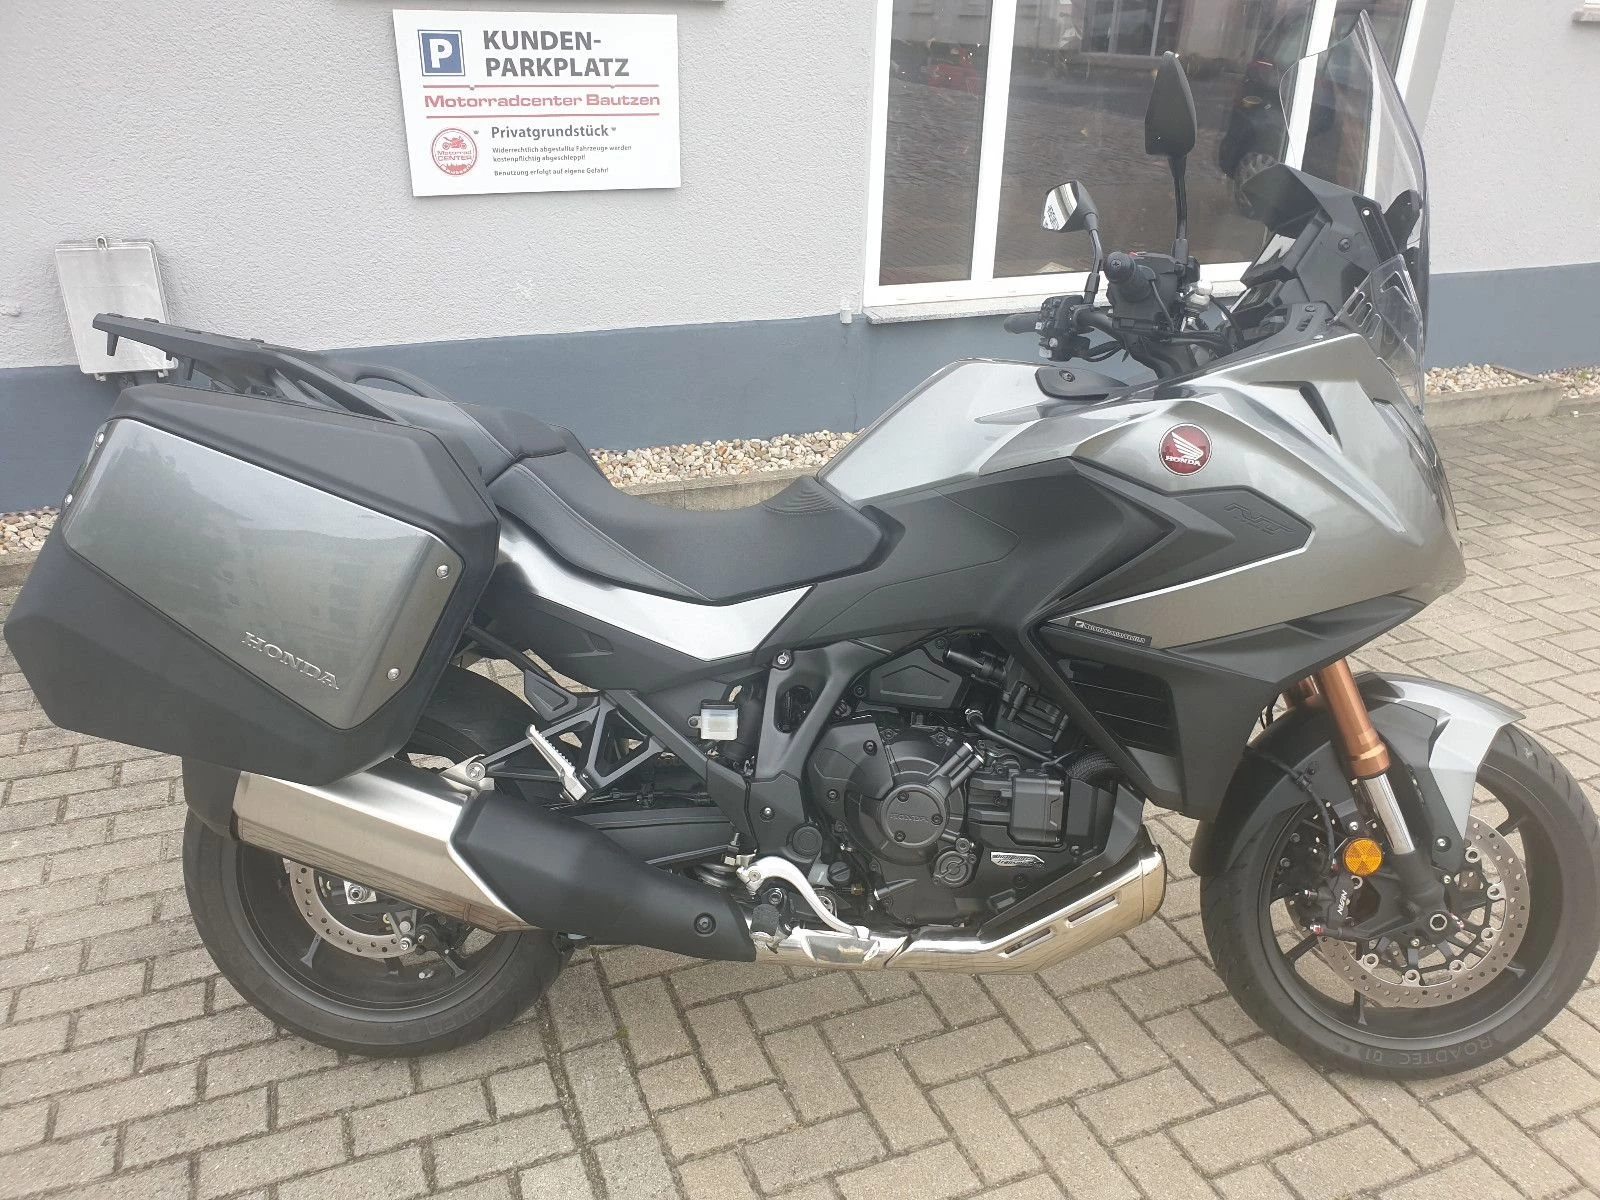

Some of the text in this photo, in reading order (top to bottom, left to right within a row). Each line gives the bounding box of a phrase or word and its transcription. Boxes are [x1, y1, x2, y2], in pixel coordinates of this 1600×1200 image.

[483, 29, 602, 51] KUNDEN-
[429, 38, 453, 69] P
[485, 57, 630, 77] PARKPLATZ
[424, 93, 661, 108] Motorradcenter Bautzen
[491, 124, 610, 141] Privatgrundstück
[540, 145, 574, 153] abgestellte
[576, 145, 608, 153] Fahrzeuge
[494, 169, 529, 177] Benutzung
[1165, 455, 1202, 467] HONDA
[241, 631, 340, 690] HONDA
[1399, 1035, 1494, 1066] ROADTEC
